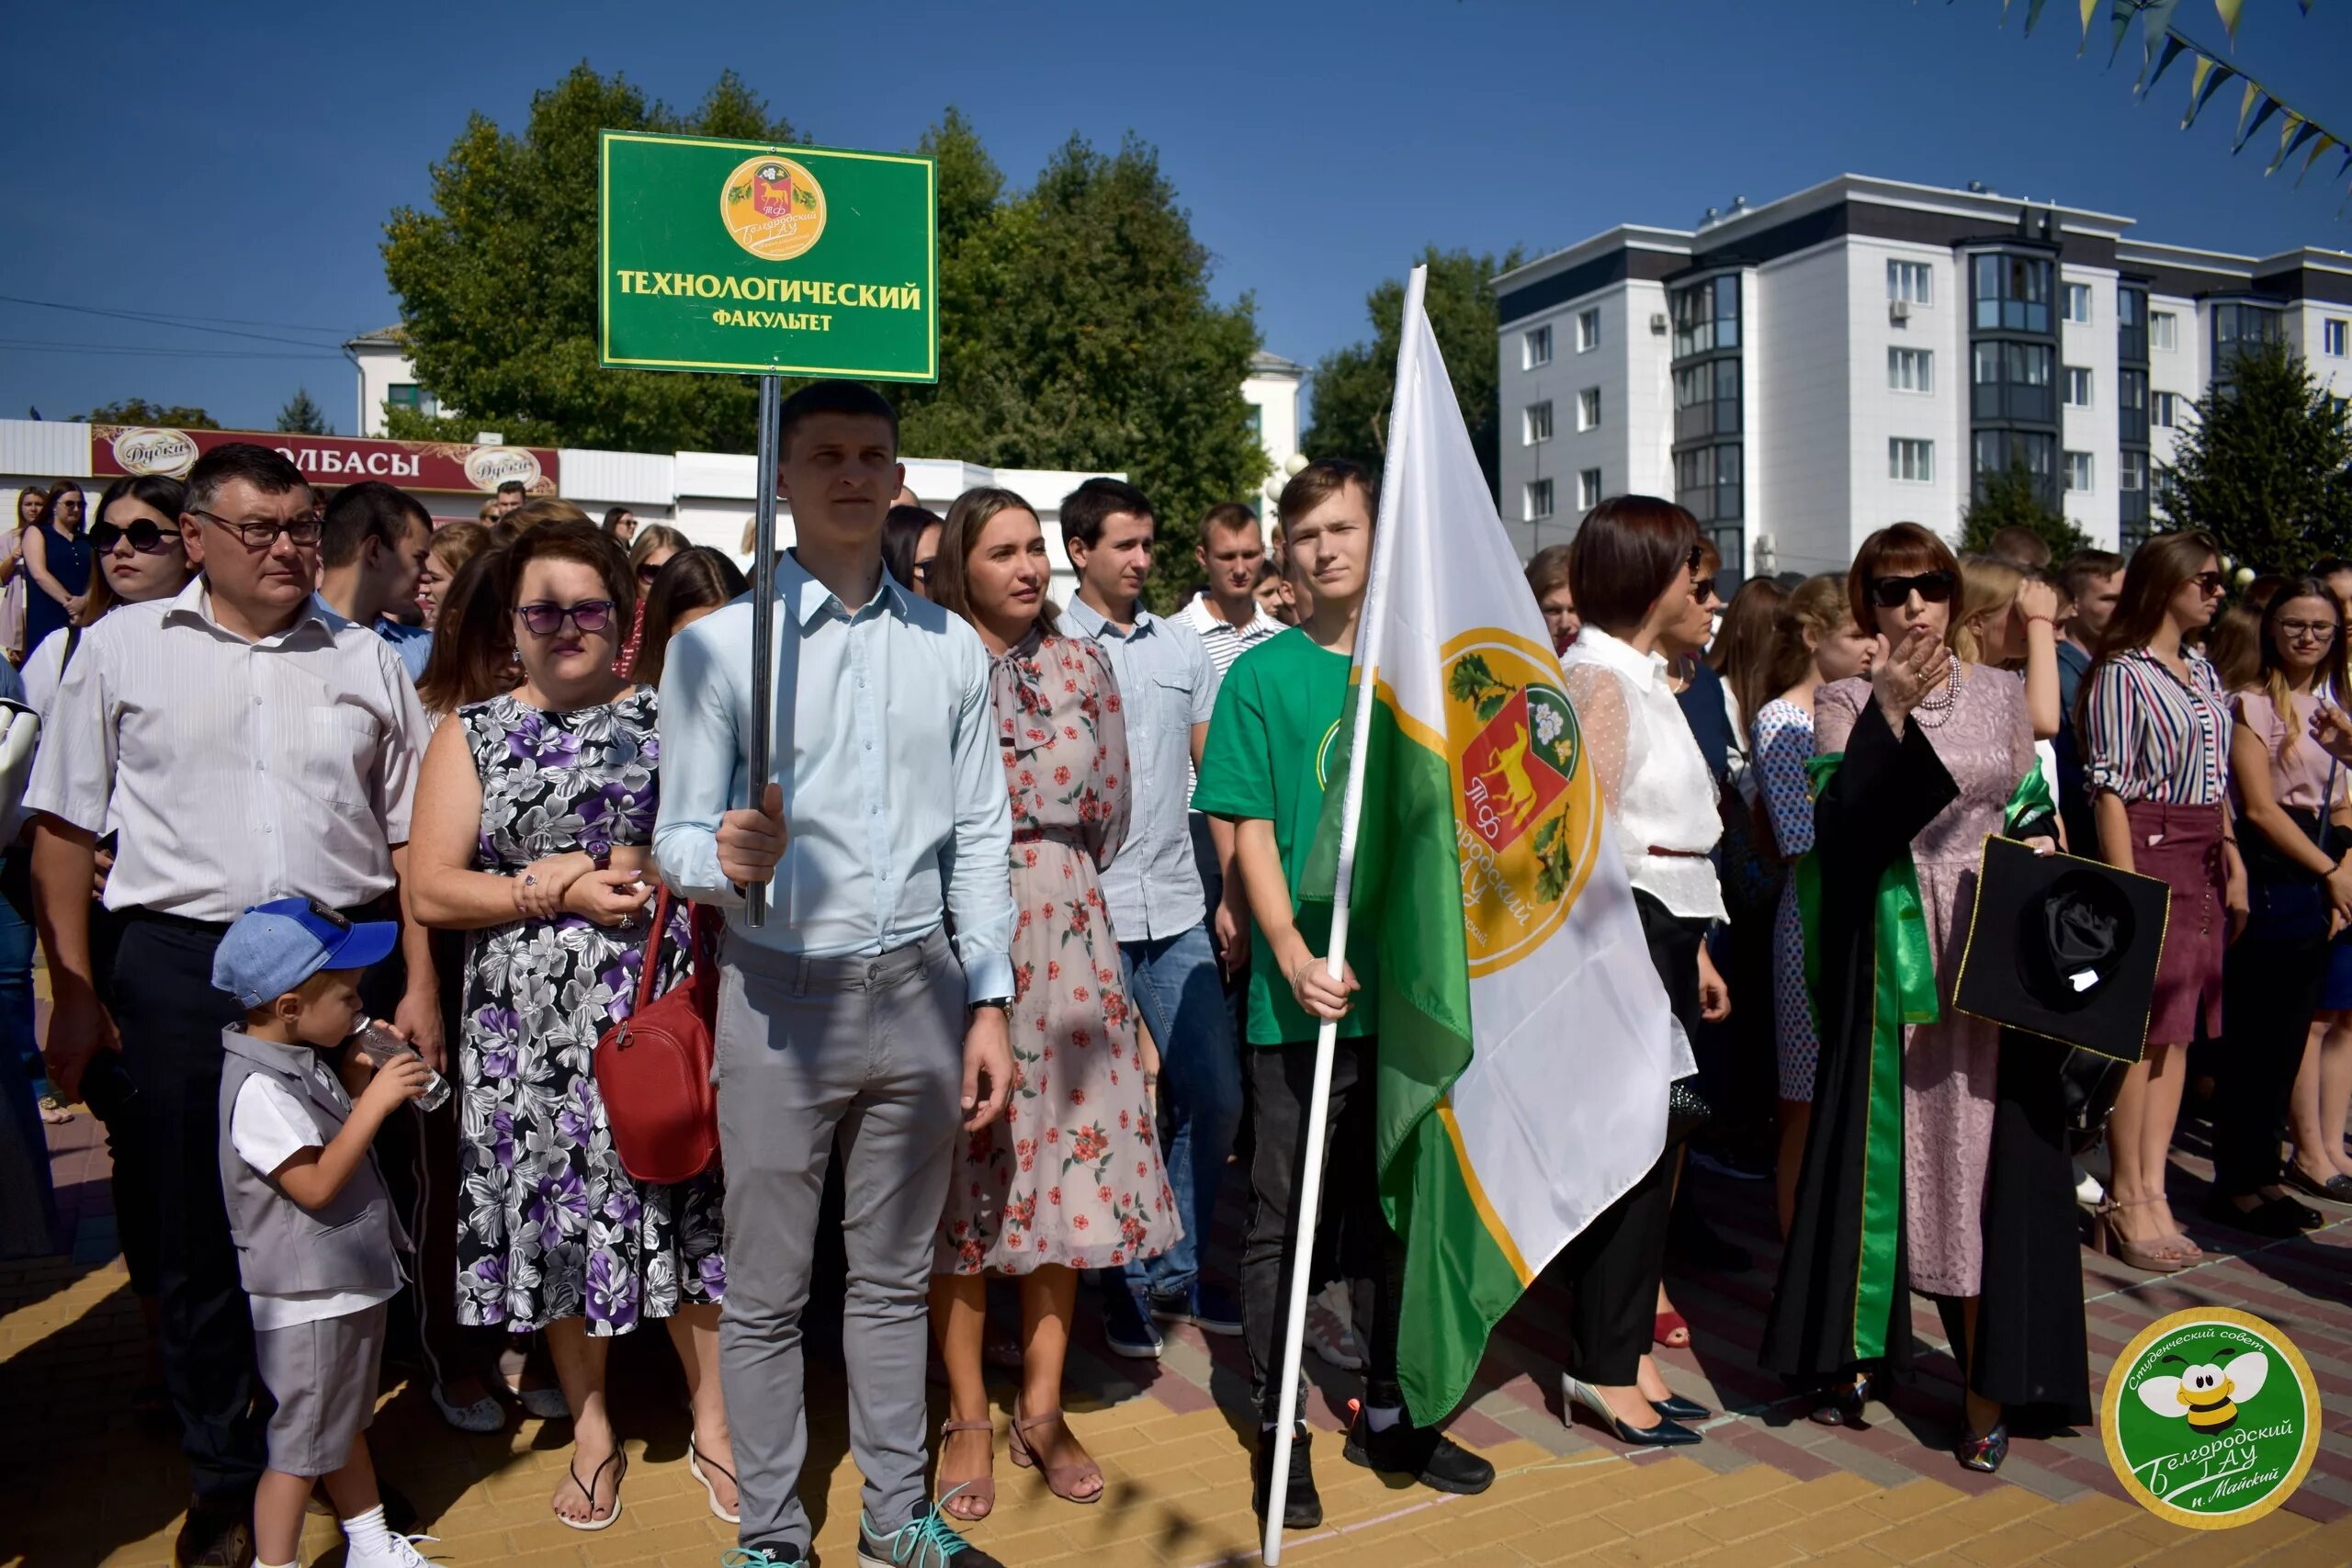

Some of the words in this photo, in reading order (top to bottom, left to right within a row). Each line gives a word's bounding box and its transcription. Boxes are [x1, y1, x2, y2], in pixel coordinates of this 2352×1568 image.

[616, 269, 922, 310] ТЕХНОЛОГИЧЕСКИЙ
[712, 309, 832, 332] ФАКУЛЬТЕТ
[126, 441, 184, 464] Дубки
[274, 446, 420, 477] ОЛБАСЫ
[1454, 818, 1535, 927] ородский
